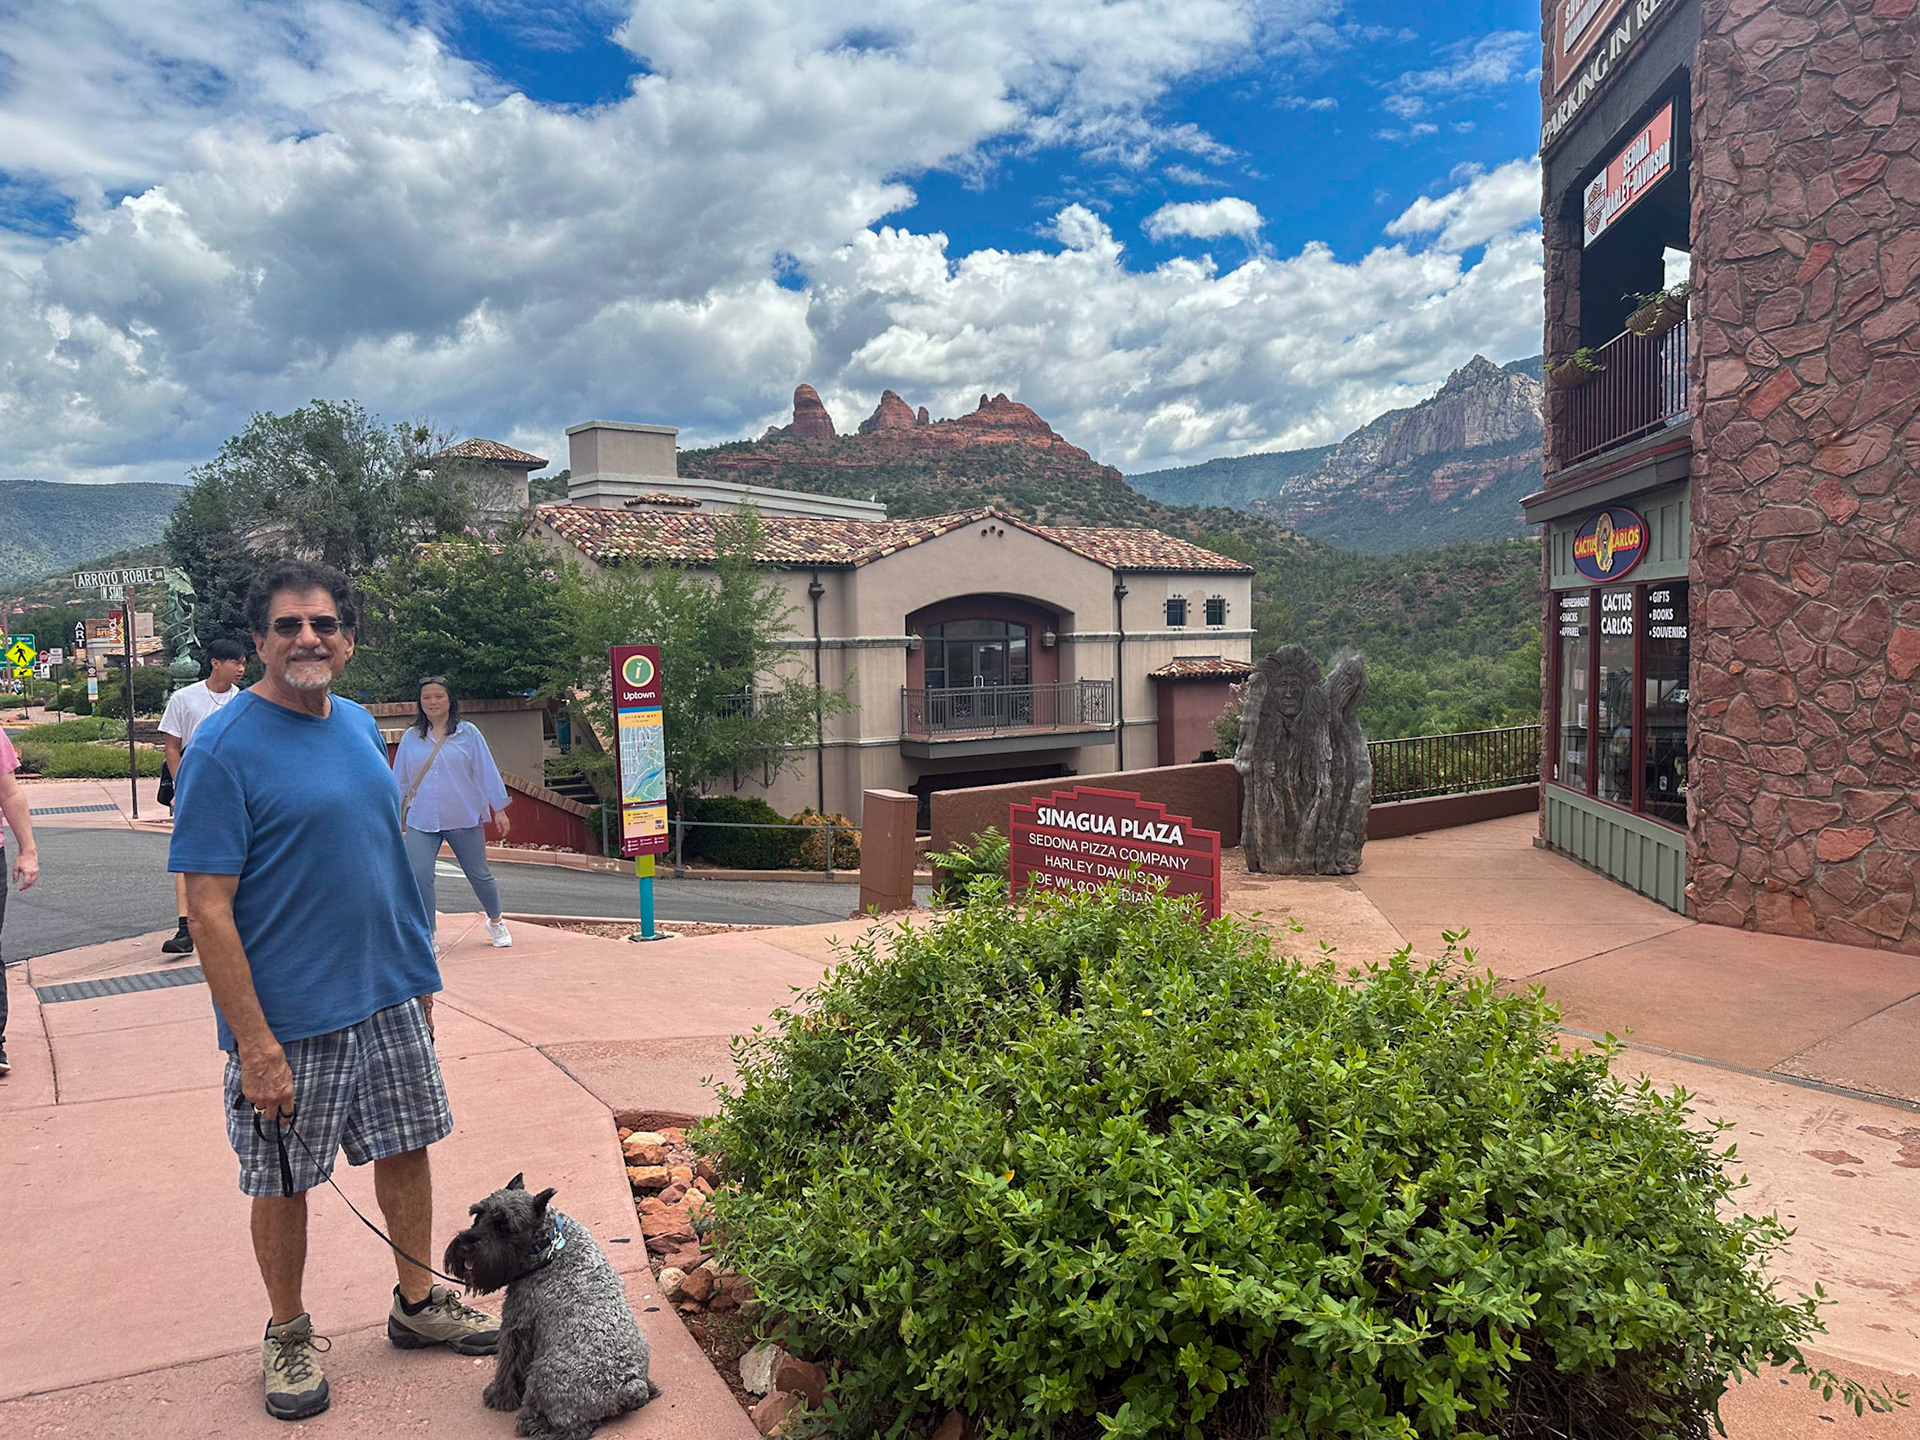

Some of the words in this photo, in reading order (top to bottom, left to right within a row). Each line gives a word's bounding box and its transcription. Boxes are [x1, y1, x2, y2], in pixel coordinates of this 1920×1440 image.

[1541, 48, 1609, 150] PARKING
[1610, 15, 1631, 61] IN
[1574, 538, 1597, 555] CACTUS
[1611, 528, 1639, 549] CARLOS
[78, 571, 118, 587] ARROYO
[122, 569, 154, 583] ROBLE
[155, 570, 163, 578] DR
[1602, 592, 1632, 612] CACTUS
[1652, 590, 1670, 603] GIFTS
[1561, 612, 1578, 623] SNACKS
[1652, 608, 1674, 620] BOOKS
[75, 621, 85, 648] ART
[109, 618, 117, 641] TOWN
[1561, 626, 1580, 637] APPAREL
[1601, 616, 1633, 635] CARLOS
[1652, 625, 1688, 639] SOUVENIRS
[623, 691, 656, 701] Uptown
[1037, 807, 1117, 836] SINAGUA
[1120, 818, 1184, 846] PLAZA
[1028, 832, 1079, 852] SEDONA
[1080, 841, 1117, 859] PIZZA
[1119, 847, 1190, 870] COMPANY
[1045, 854, 1094, 874] HARLEY
[1035, 872, 1052, 886] OE
